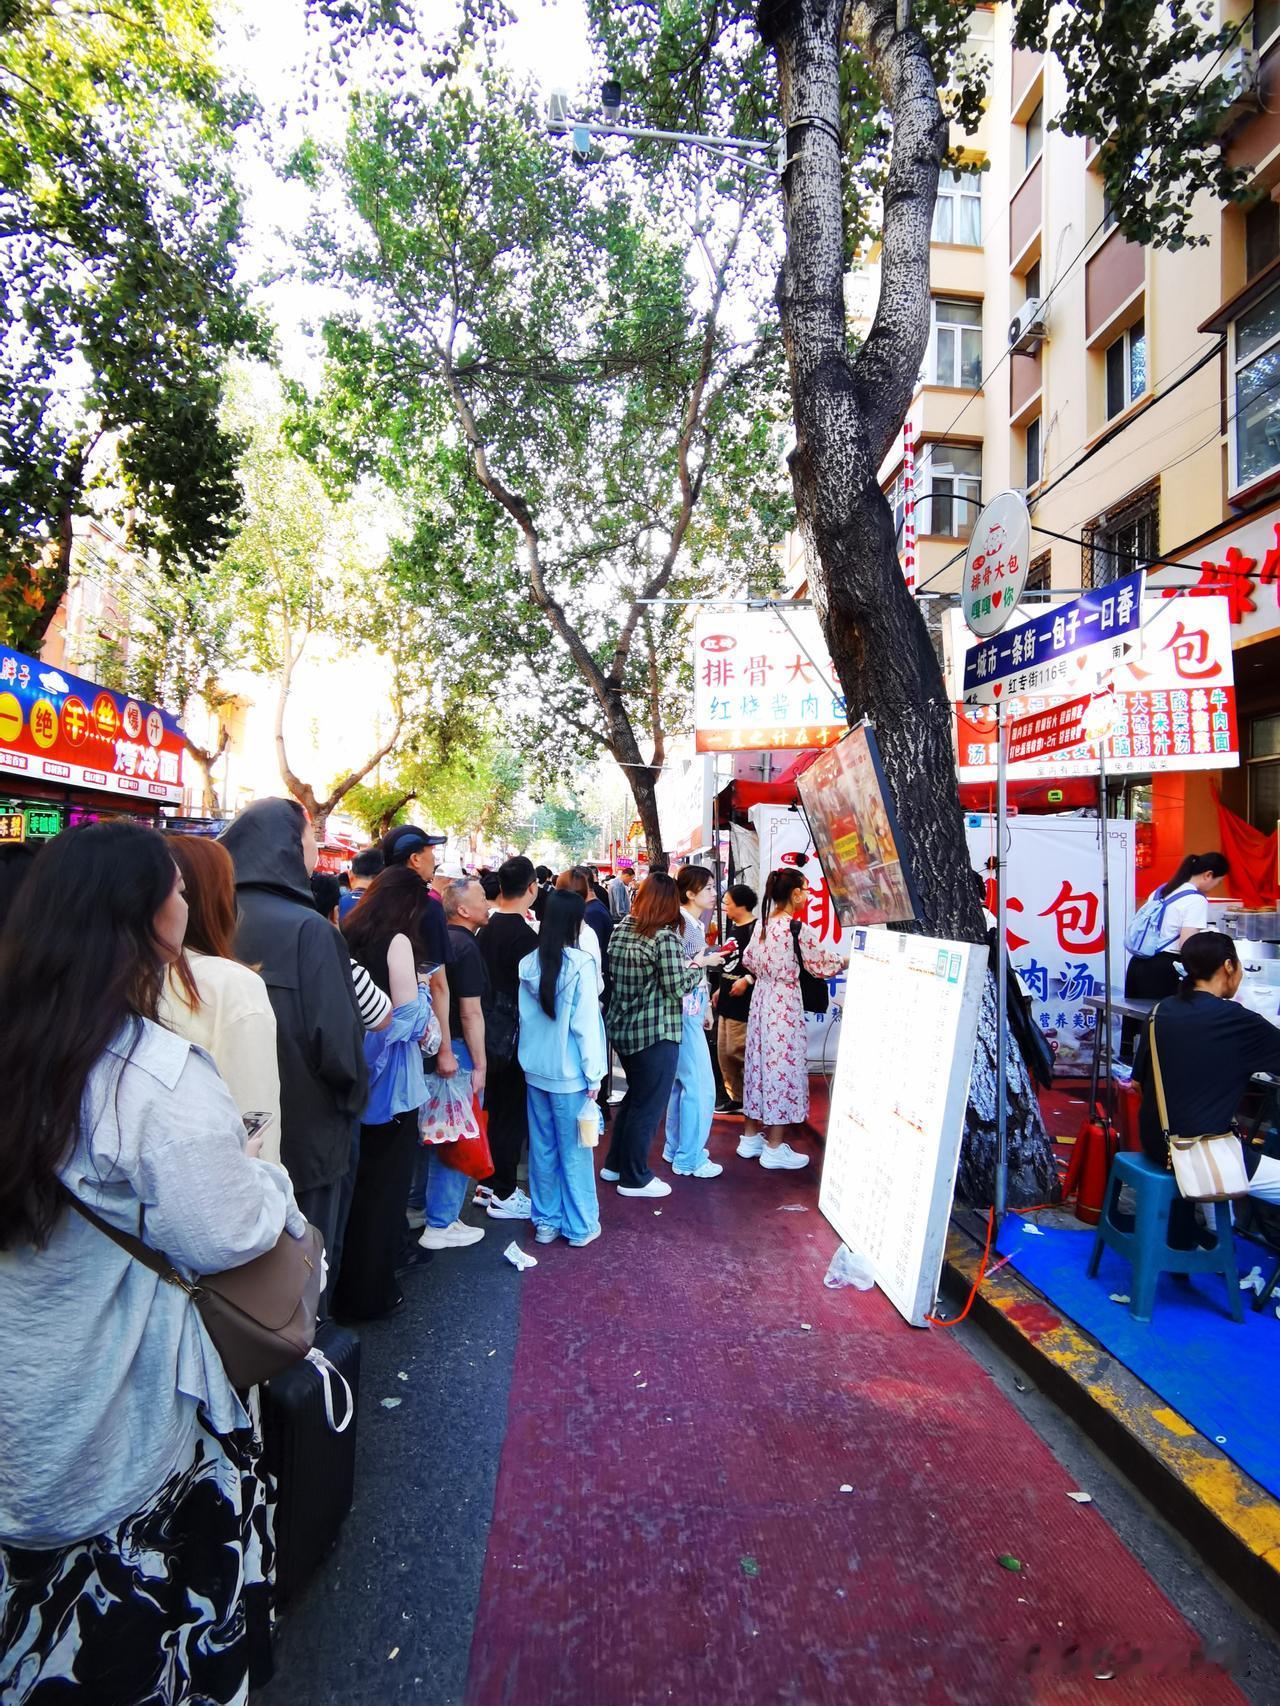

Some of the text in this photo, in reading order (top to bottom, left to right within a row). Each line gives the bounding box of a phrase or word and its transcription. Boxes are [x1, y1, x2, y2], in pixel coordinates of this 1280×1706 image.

[971, 555, 1019, 591] 排骨大包
[967, 585, 1134, 679] 一城市 一条街 一包子 一口香
[1112, 645, 1122, 659] 南
[1008, 661, 1068, 695] 红专街116号
[1151, 691, 1171, 755] 玉米汁
[1171, 690, 1191, 753] 酸菜汤
[1211, 688, 1230, 752] 牛肉面
[113, 738, 179, 785] 烤冷面
